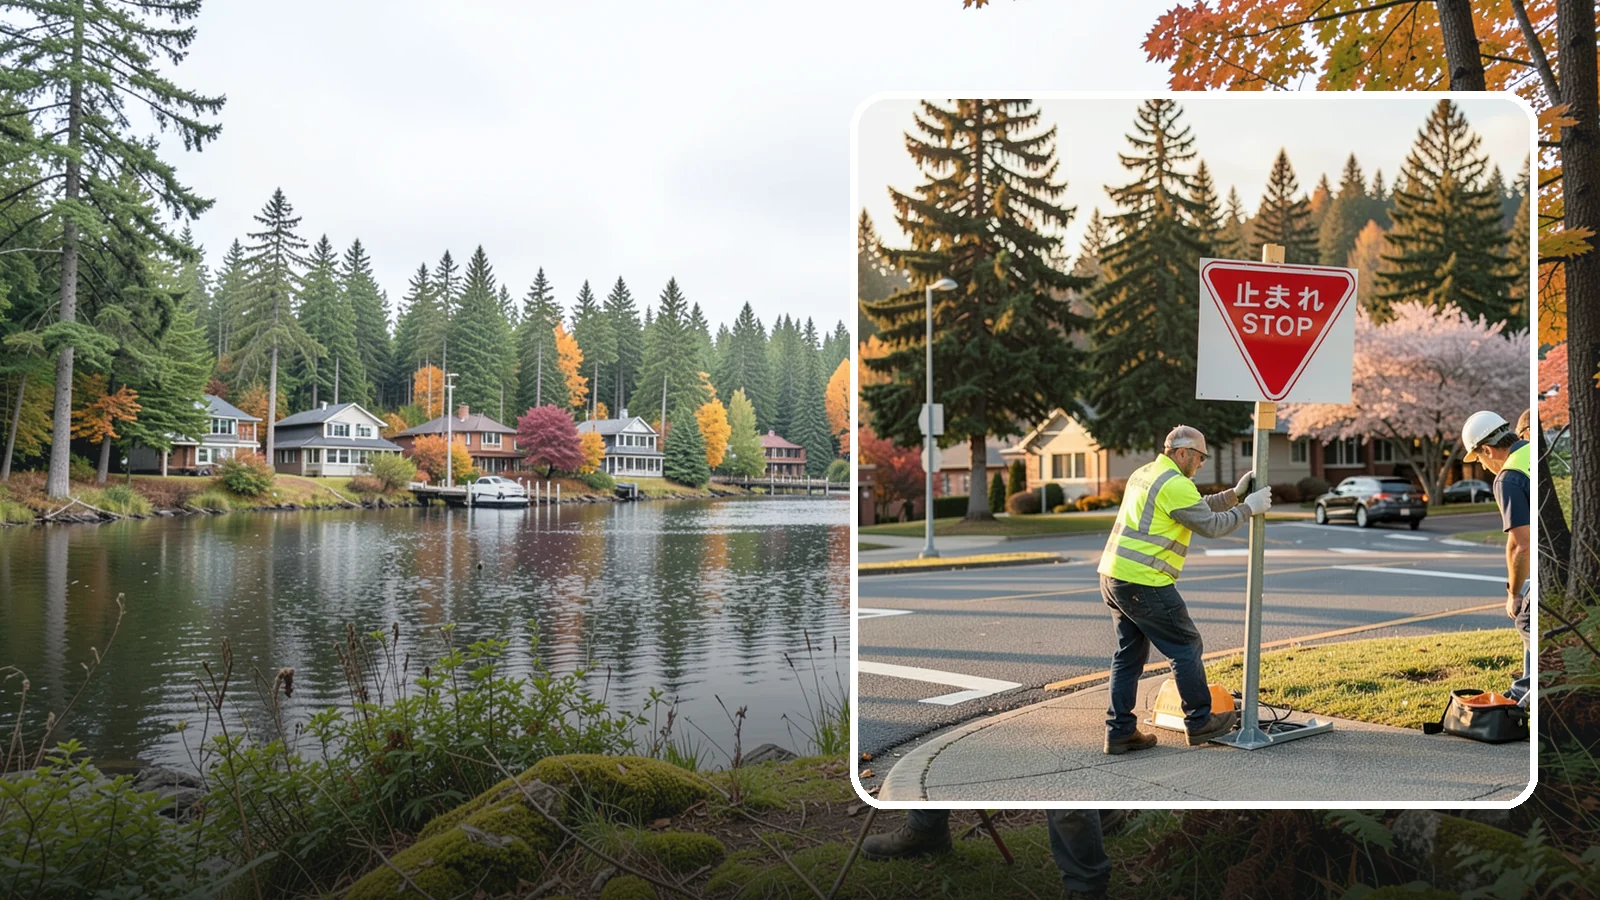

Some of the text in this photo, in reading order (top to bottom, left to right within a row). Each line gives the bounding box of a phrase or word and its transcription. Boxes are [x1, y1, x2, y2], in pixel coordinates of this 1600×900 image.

[1233, 281, 1324, 311] 止まれ
[1242, 312, 1313, 336] STOP
